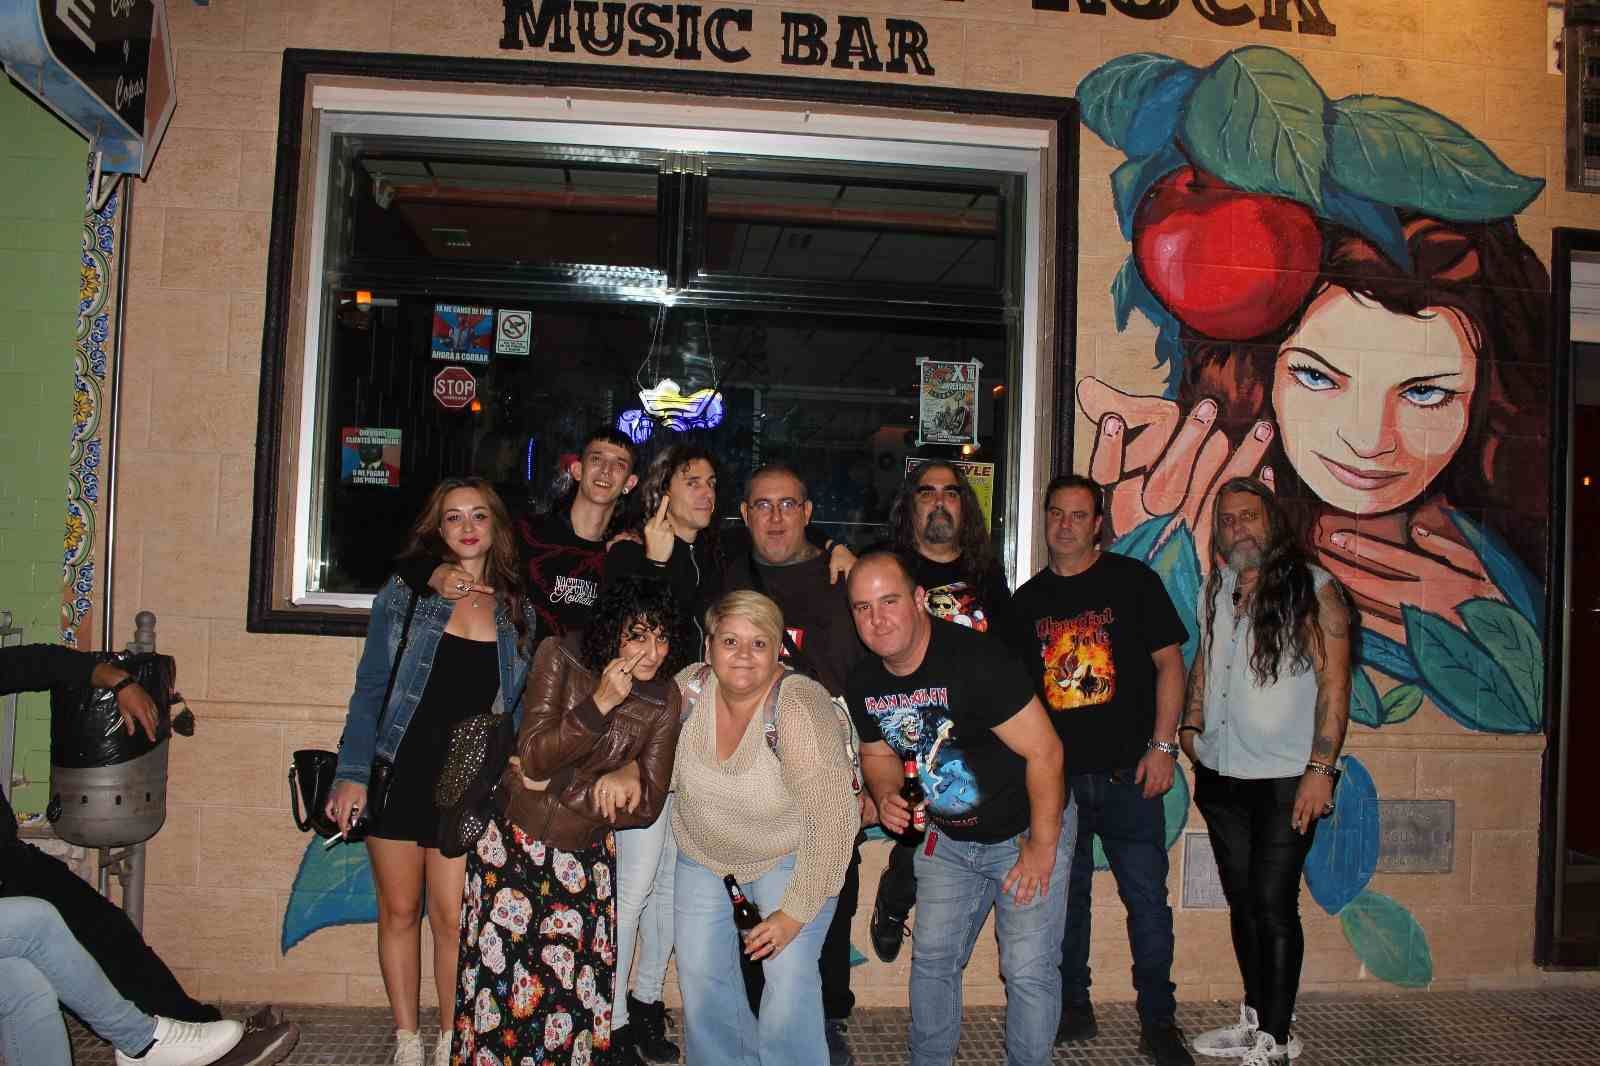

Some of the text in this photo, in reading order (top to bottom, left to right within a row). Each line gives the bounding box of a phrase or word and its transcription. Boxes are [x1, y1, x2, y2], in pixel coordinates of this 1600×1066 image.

[499, 0, 936, 76] MUSIC BAR
[115, 75, 145, 111] Copas
[432, 350, 488, 362] AHORA A COBRAR
[436, 379, 474, 396] STOP
[554, 575, 598, 598] NOCTURNAL
[864, 687, 949, 716] IRON MAIDEN
